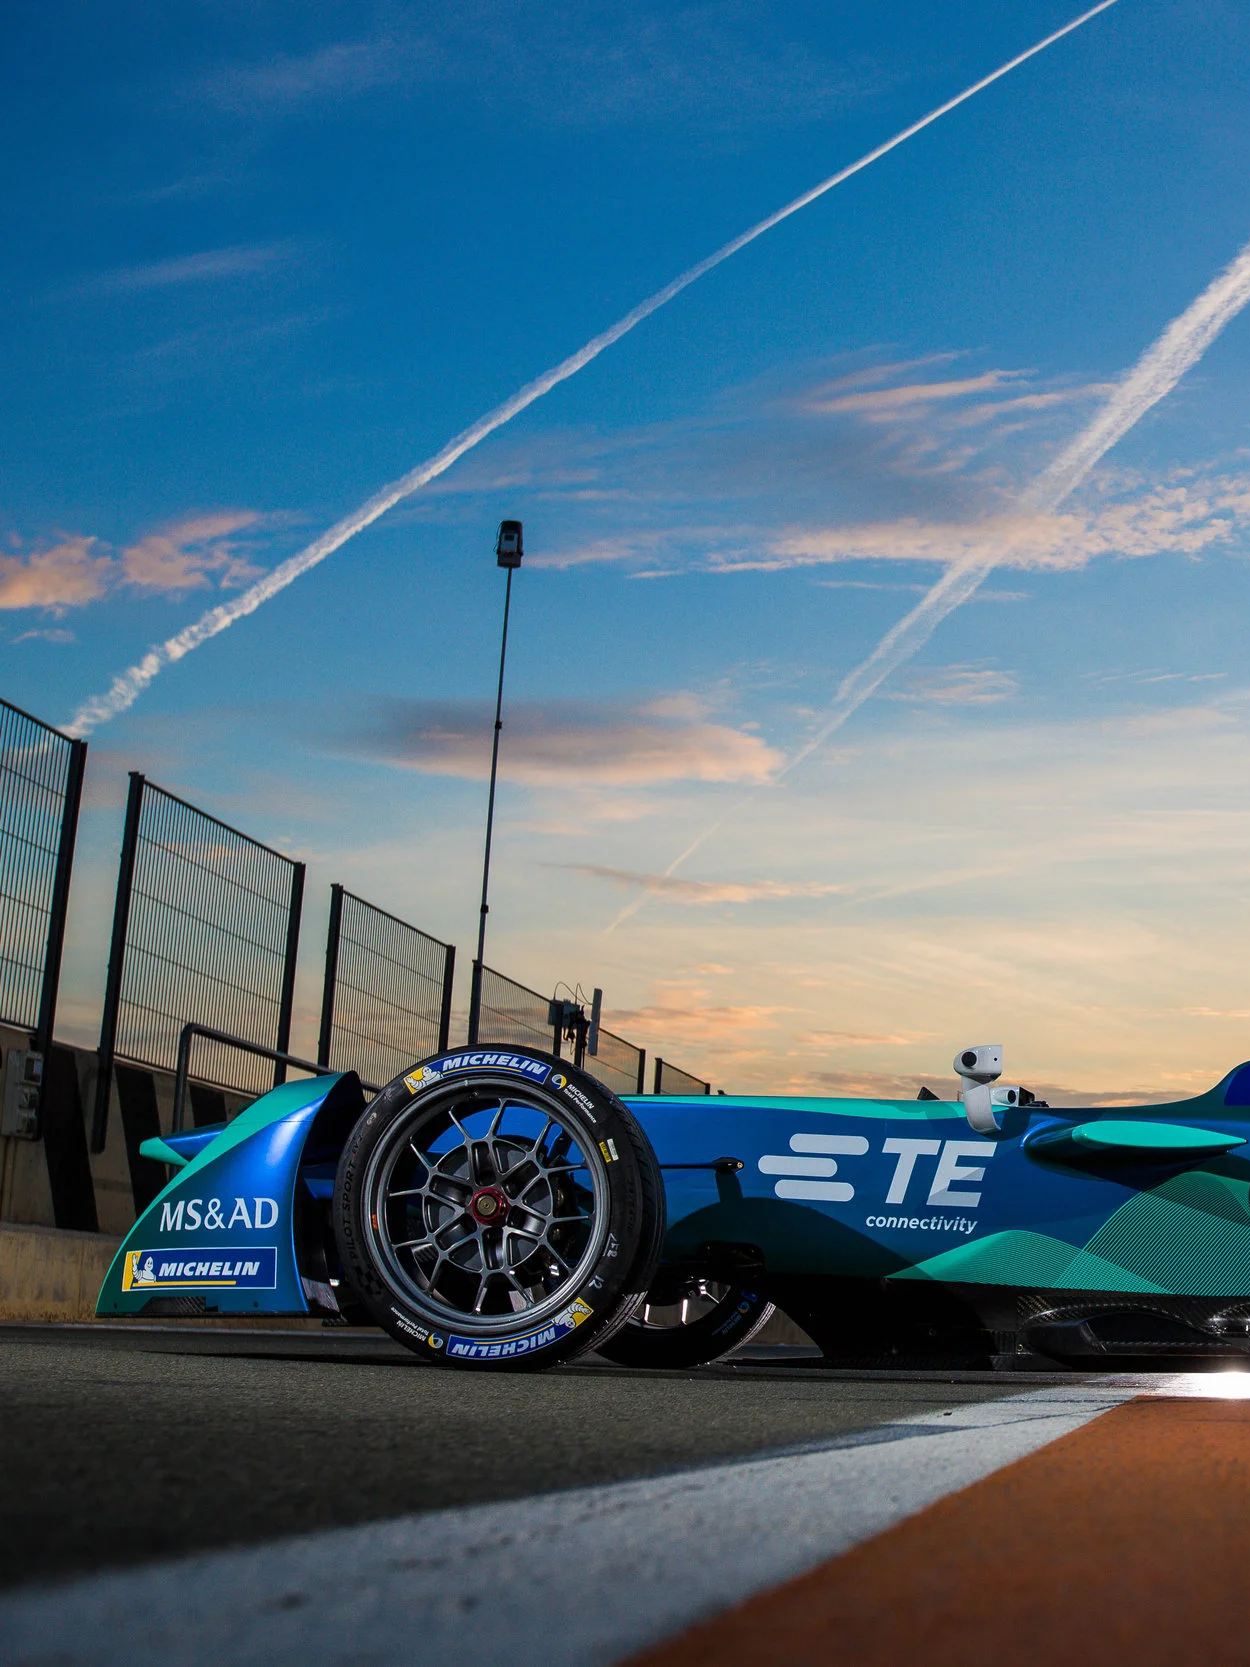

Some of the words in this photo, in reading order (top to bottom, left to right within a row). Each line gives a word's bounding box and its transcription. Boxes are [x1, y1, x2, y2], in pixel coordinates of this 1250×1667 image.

[442, 1054, 547, 1076] MICHELIN
[563, 1088, 575, 1099] Total
[573, 1097, 597, 1124] Performance
[567, 1084, 595, 1110] MICHELIN
[882, 1137, 998, 1207] TE
[343, 1161, 356, 1213] SPORT
[159, 1198, 279, 1232] MS&AD
[866, 1215, 978, 1235] connectivity
[343, 1217, 358, 1260] PILOT
[158, 1261, 260, 1277] MICHELIN
[391, 1306, 419, 1329] Performance
[396, 1320, 427, 1342] MICHELIN
[451, 1326, 556, 1357] MICHELIN
